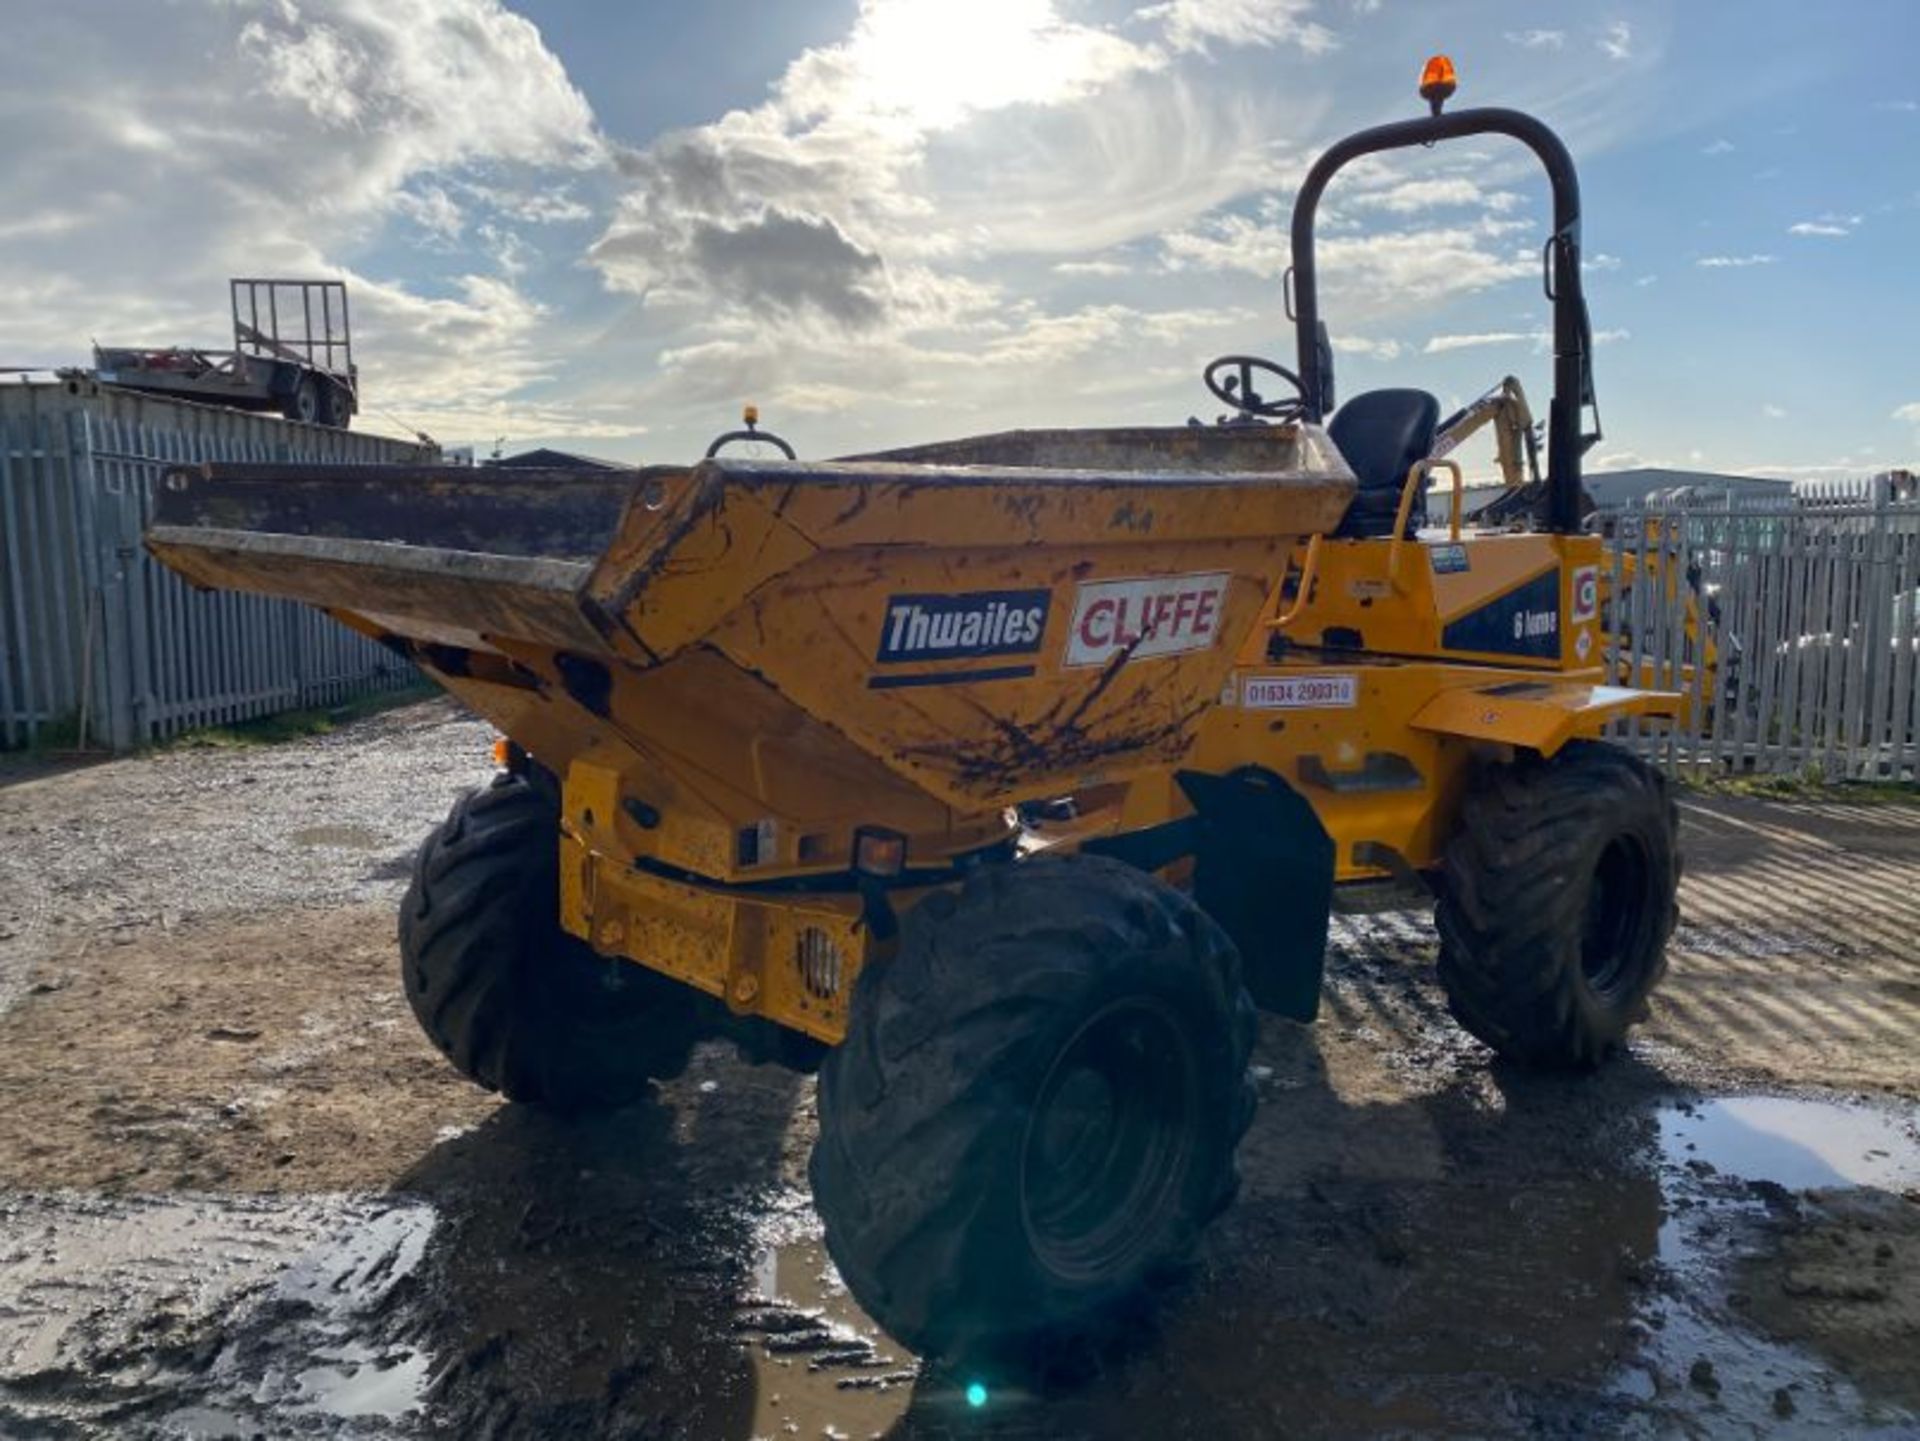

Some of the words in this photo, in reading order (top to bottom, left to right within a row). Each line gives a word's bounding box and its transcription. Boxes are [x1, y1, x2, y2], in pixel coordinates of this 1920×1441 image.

[888, 602, 1043, 651] Thwaites
[1079, 589, 1219, 649] CLIFFE
[1250, 685, 1294, 702] 01634
